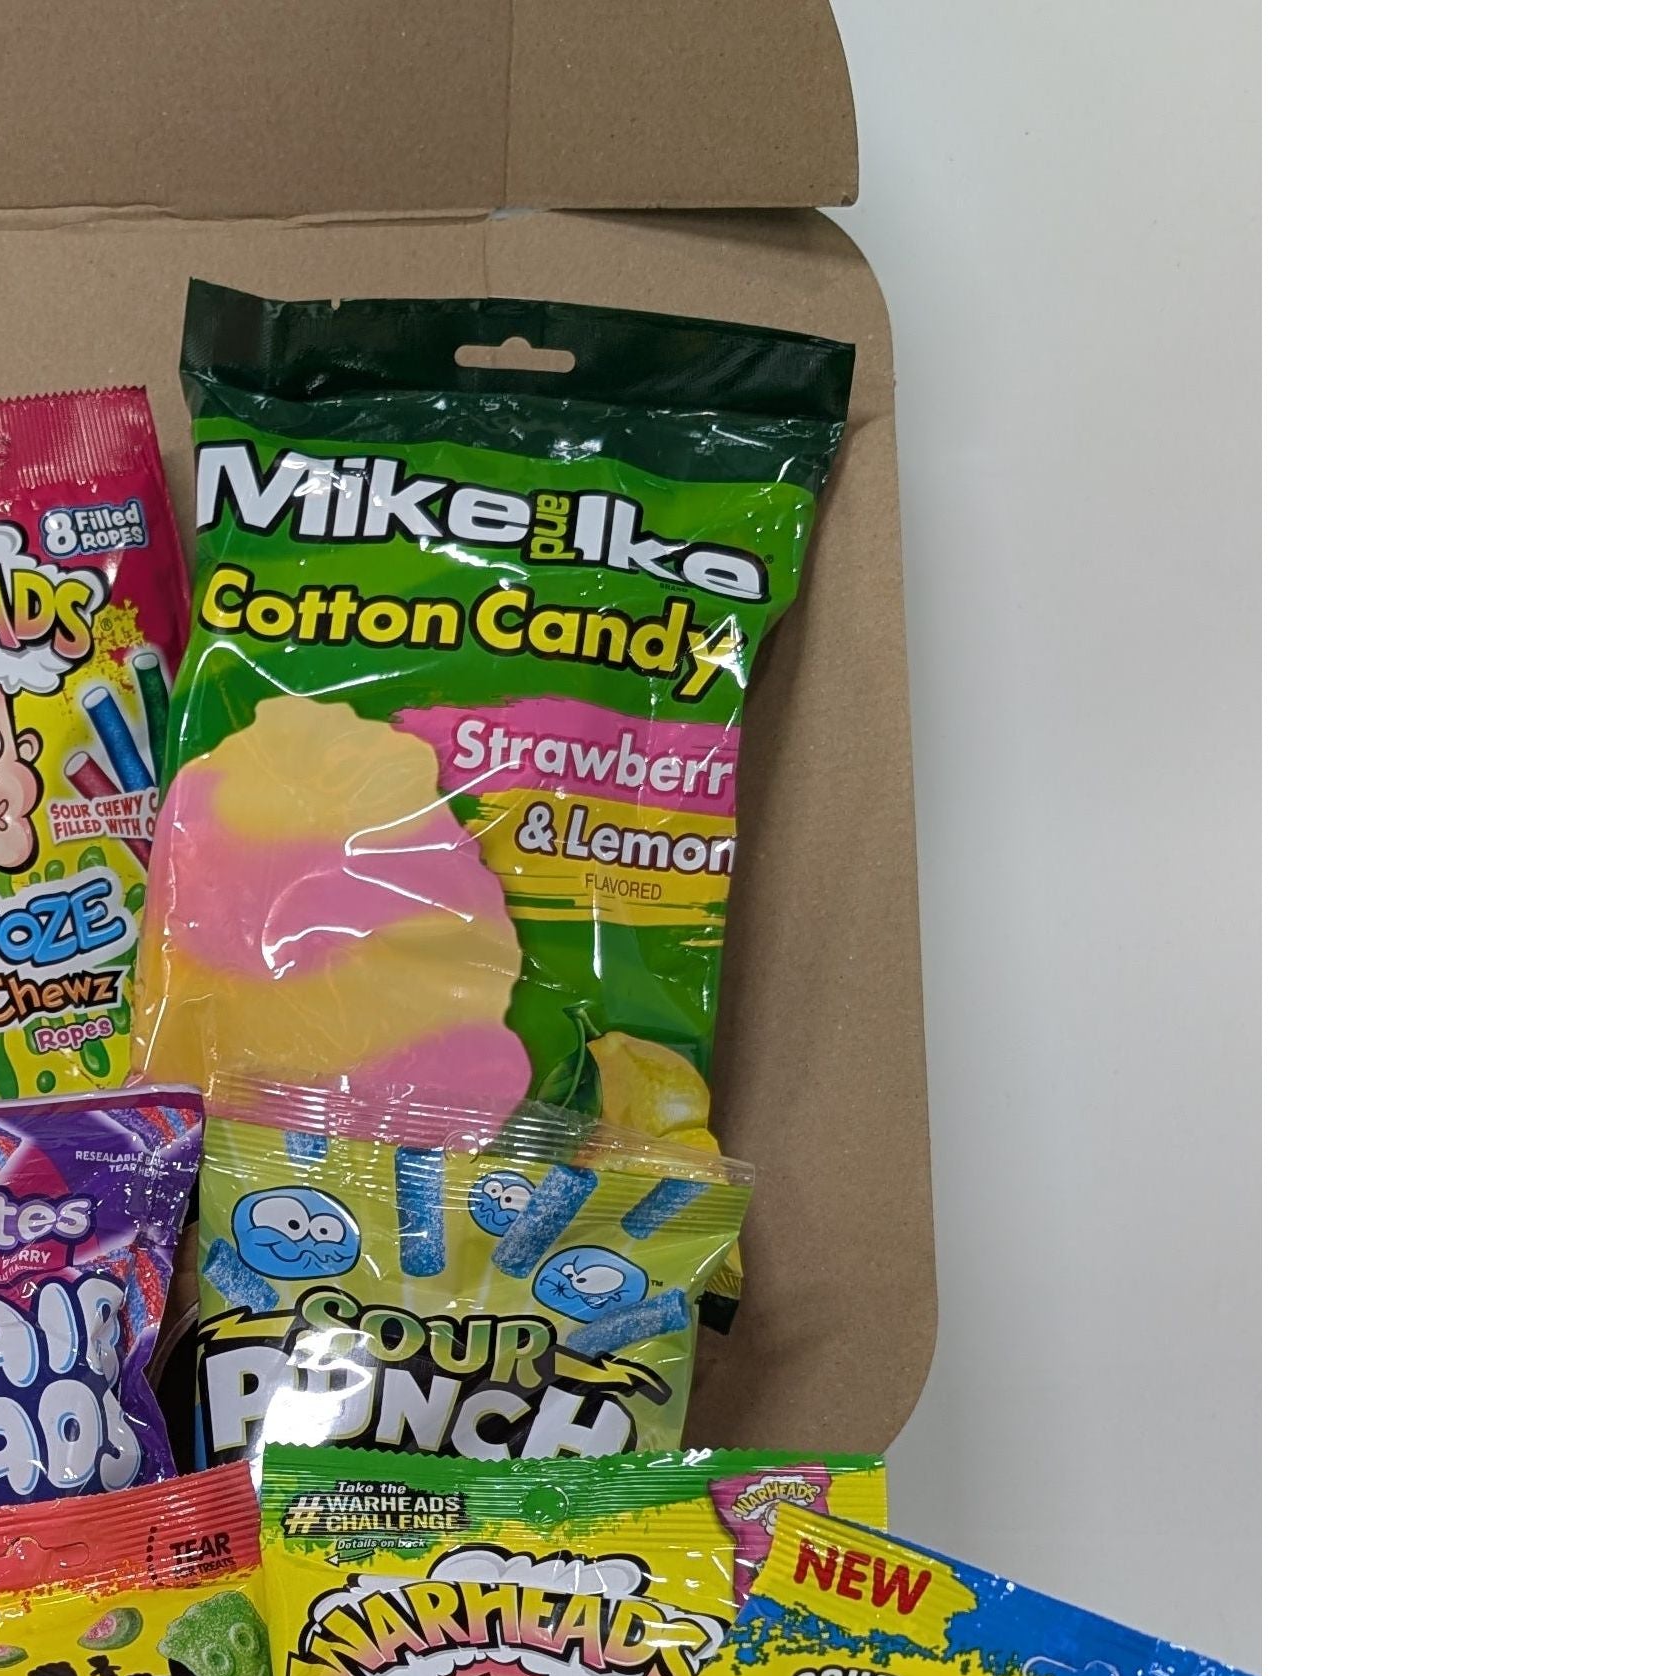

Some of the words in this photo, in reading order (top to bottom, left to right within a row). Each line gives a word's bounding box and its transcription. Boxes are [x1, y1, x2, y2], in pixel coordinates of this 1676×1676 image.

[46, 512, 78, 553] 8
[78, 501, 141, 531] Filled
[81, 526, 145, 549] ROPES
[196, 443, 530, 545] Mike
[530, 495, 575, 562] and
[574, 493, 765, 600] Ike
[202, 570, 458, 648] Cotton
[476, 590, 748, 700] Candy
[452, 720, 734, 796] Strawberr
[49, 802, 91, 820] SOUR
[95, 796, 142, 818] CHEWY
[53, 819, 103, 840] FILLED
[105, 818, 143, 836] WITH
[517, 807, 556, 856] &
[564, 812, 734, 876] Lemon
[583, 872, 663, 901] FLAVORED
[35, 1018, 114, 1053] Ropes
[74, 1149, 144, 1164] RESEALABLE
[108, 1163, 137, 1174] TEAR
[295, 1291, 552, 1389] SOUR
[206, 1346, 634, 1460] PUNCH
[337, 1481, 374, 1496] Take
[379, 1481, 408, 1496] the
[731, 1480, 819, 1516] WARHEADS
[324, 1512, 460, 1533] CHALLENGE
[170, 1531, 232, 1566] TEAR
[336, 1536, 378, 1552] Details
[381, 1539, 397, 1550] on
[397, 1537, 427, 1551] back
[199, 1557, 237, 1575] TREATS
[793, 1538, 934, 1615] NEW
